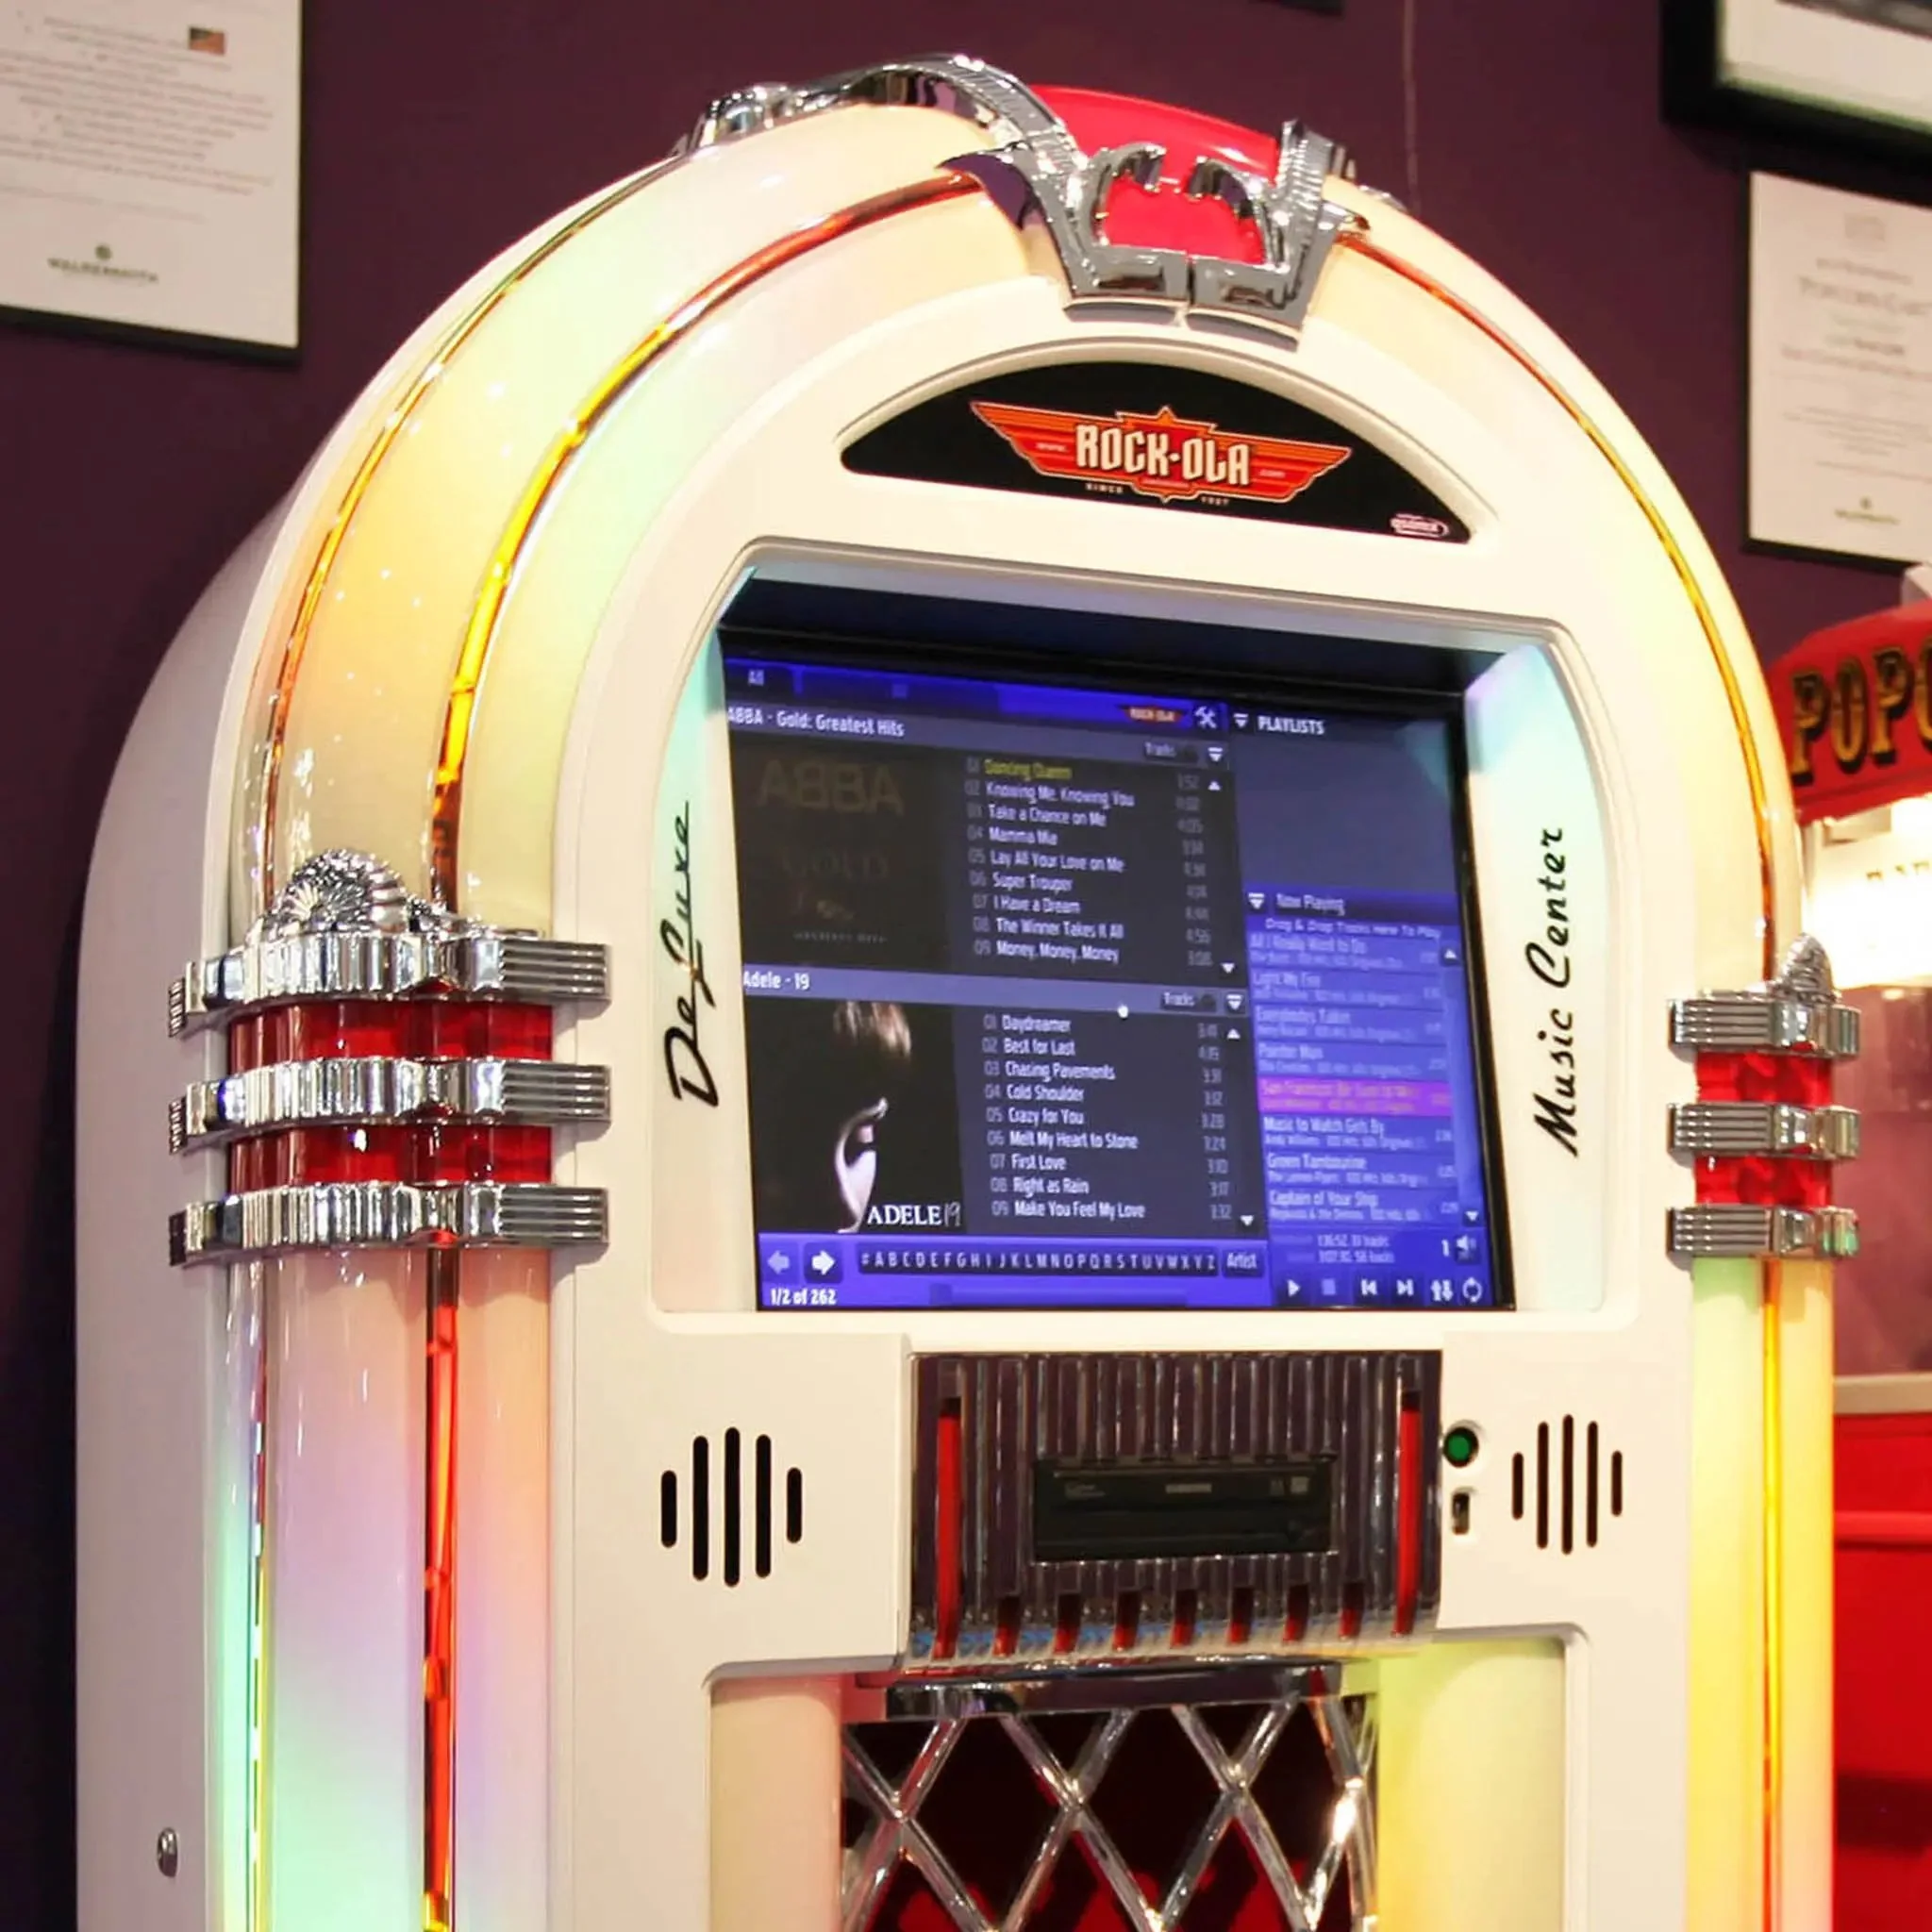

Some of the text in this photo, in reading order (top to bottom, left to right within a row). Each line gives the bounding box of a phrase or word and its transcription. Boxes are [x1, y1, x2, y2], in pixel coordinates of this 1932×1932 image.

[1074, 424, 1250, 487] ROCK-OLA
[815, 713, 875, 735] Greatest
[876, 719, 906, 737] Hits
[1257, 714, 1325, 736] PLAYLISTS
[1112, 790, 1136, 808] You
[996, 917, 1018, 934] The
[1062, 920, 1097, 939] Takes
[1081, 944, 1120, 965] Money
[742, 970, 782, 990] Adele
[793, 972, 811, 991] 19
[1524, 827, 1579, 1158] Music Center
[1002, 1014, 1072, 1035] Daydreamer
[1003, 1037, 1030, 1055] Best
[1031, 1039, 1049, 1056] for
[1050, 1040, 1076, 1057] Last
[1005, 1059, 1052, 1083] Chasing
[1052, 1061, 1117, 1082] Pavements
[1006, 1082, 1033, 1101] Cold
[1033, 1084, 1085, 1103] Shoulder
[1008, 1106, 1040, 1127] Crazy
[1041, 1108, 1058, 1124] for
[1060, 1108, 1086, 1126] You
[1009, 1129, 1036, 1148] Melt
[1037, 1130, 1055, 1151] My
[1056, 1131, 1090, 1150] Heart
[1090, 1133, 1104, 1149] to
[1105, 1132, 1140, 1150] Stone
[1010, 1153, 1037, 1171] First
[1038, 1154, 1068, 1172] Love
[1012, 1175, 1045, 1199] Right
[1046, 1178, 1061, 1194] as
[1062, 1176, 1091, 1195] Rain
[866, 1201, 961, 1227] ADELE 19
[1014, 1199, 1046, 1218] Make
[1047, 1200, 1072, 1219] You
[1072, 1201, 1098, 1219] Feel
[1098, 1201, 1116, 1223] My
[1117, 1202, 1147, 1220] Love
[770, 1287, 838, 1307] 1/2 of 262
